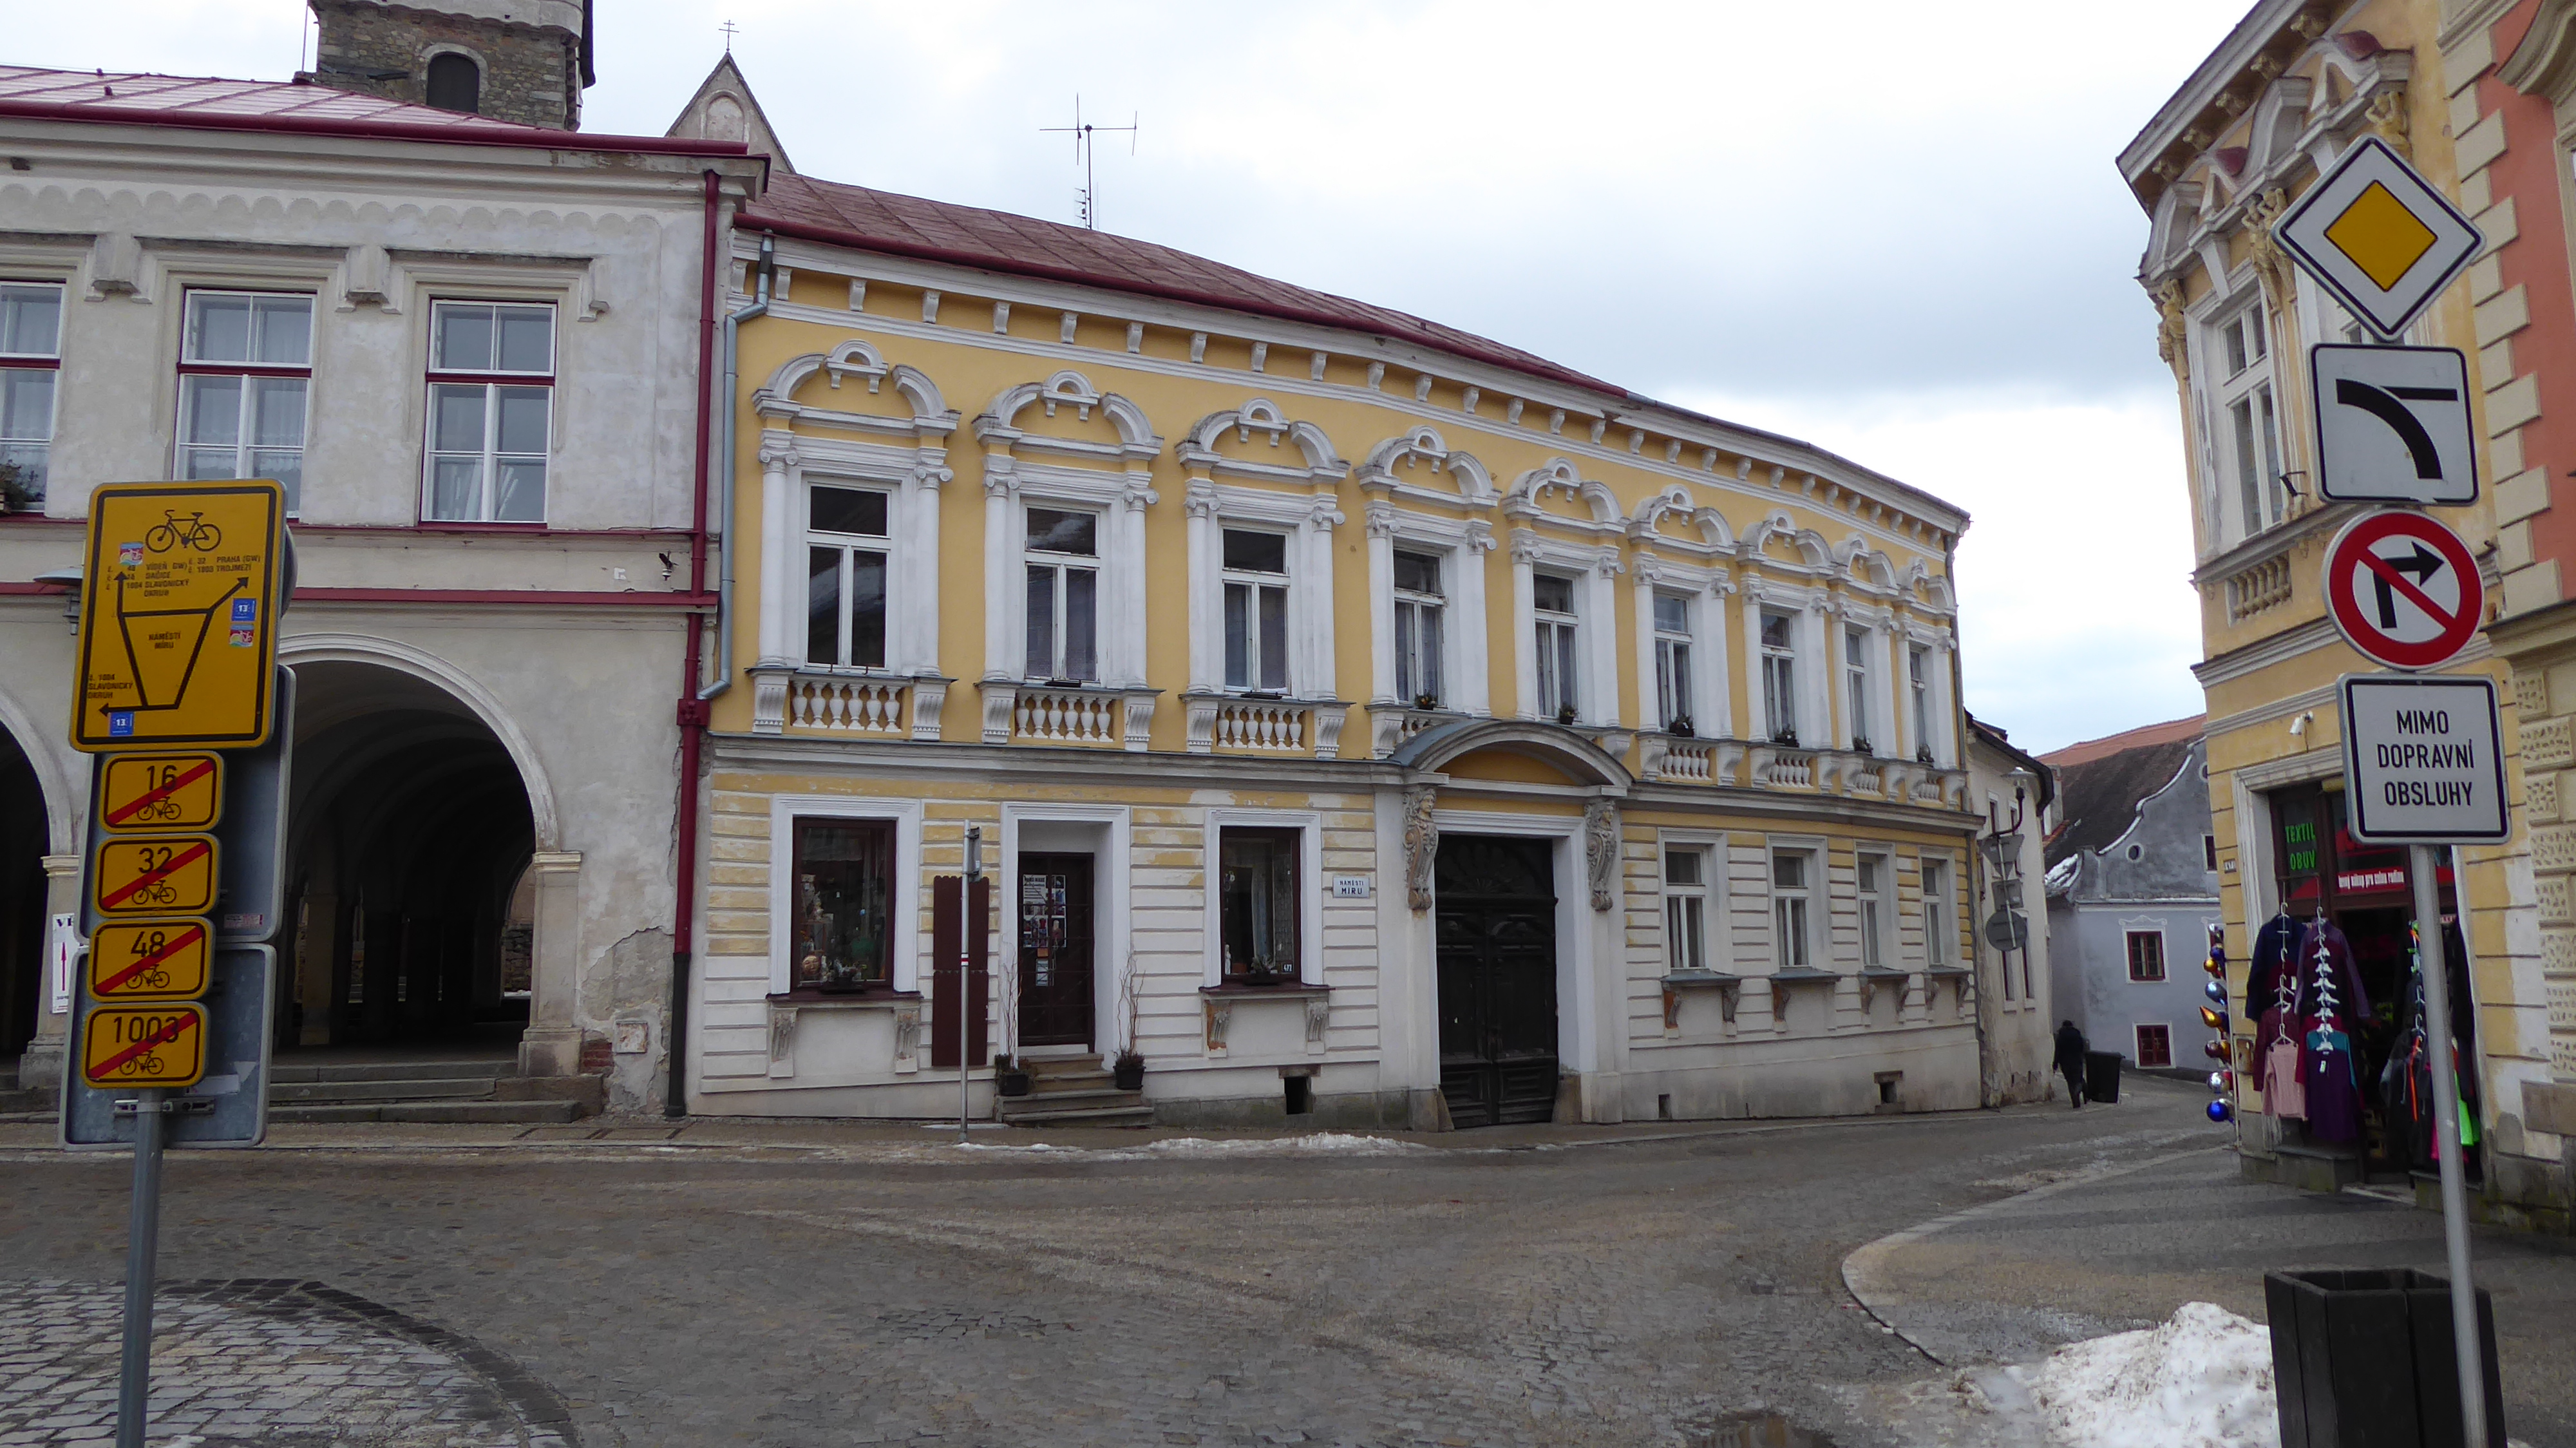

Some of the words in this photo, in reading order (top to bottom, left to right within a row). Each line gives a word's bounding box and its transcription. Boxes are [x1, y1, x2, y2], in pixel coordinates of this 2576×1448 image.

[238, 604, 248, 613] 13
[116, 718, 126, 727] 13
[2396, 710, 2449, 734] MIMO
[2377, 738, 2474, 768] DOPRAVNÍ
[146, 765, 177, 791] 16
[2384, 781, 2472, 806] OBSLUHY
[2285, 822, 2316, 844] TEXTIL
[138, 847, 172, 874] 32
[2289, 849, 2316, 871] OBUV
[130, 931, 166, 957] 48
[113, 1016, 179, 1043] 1003
